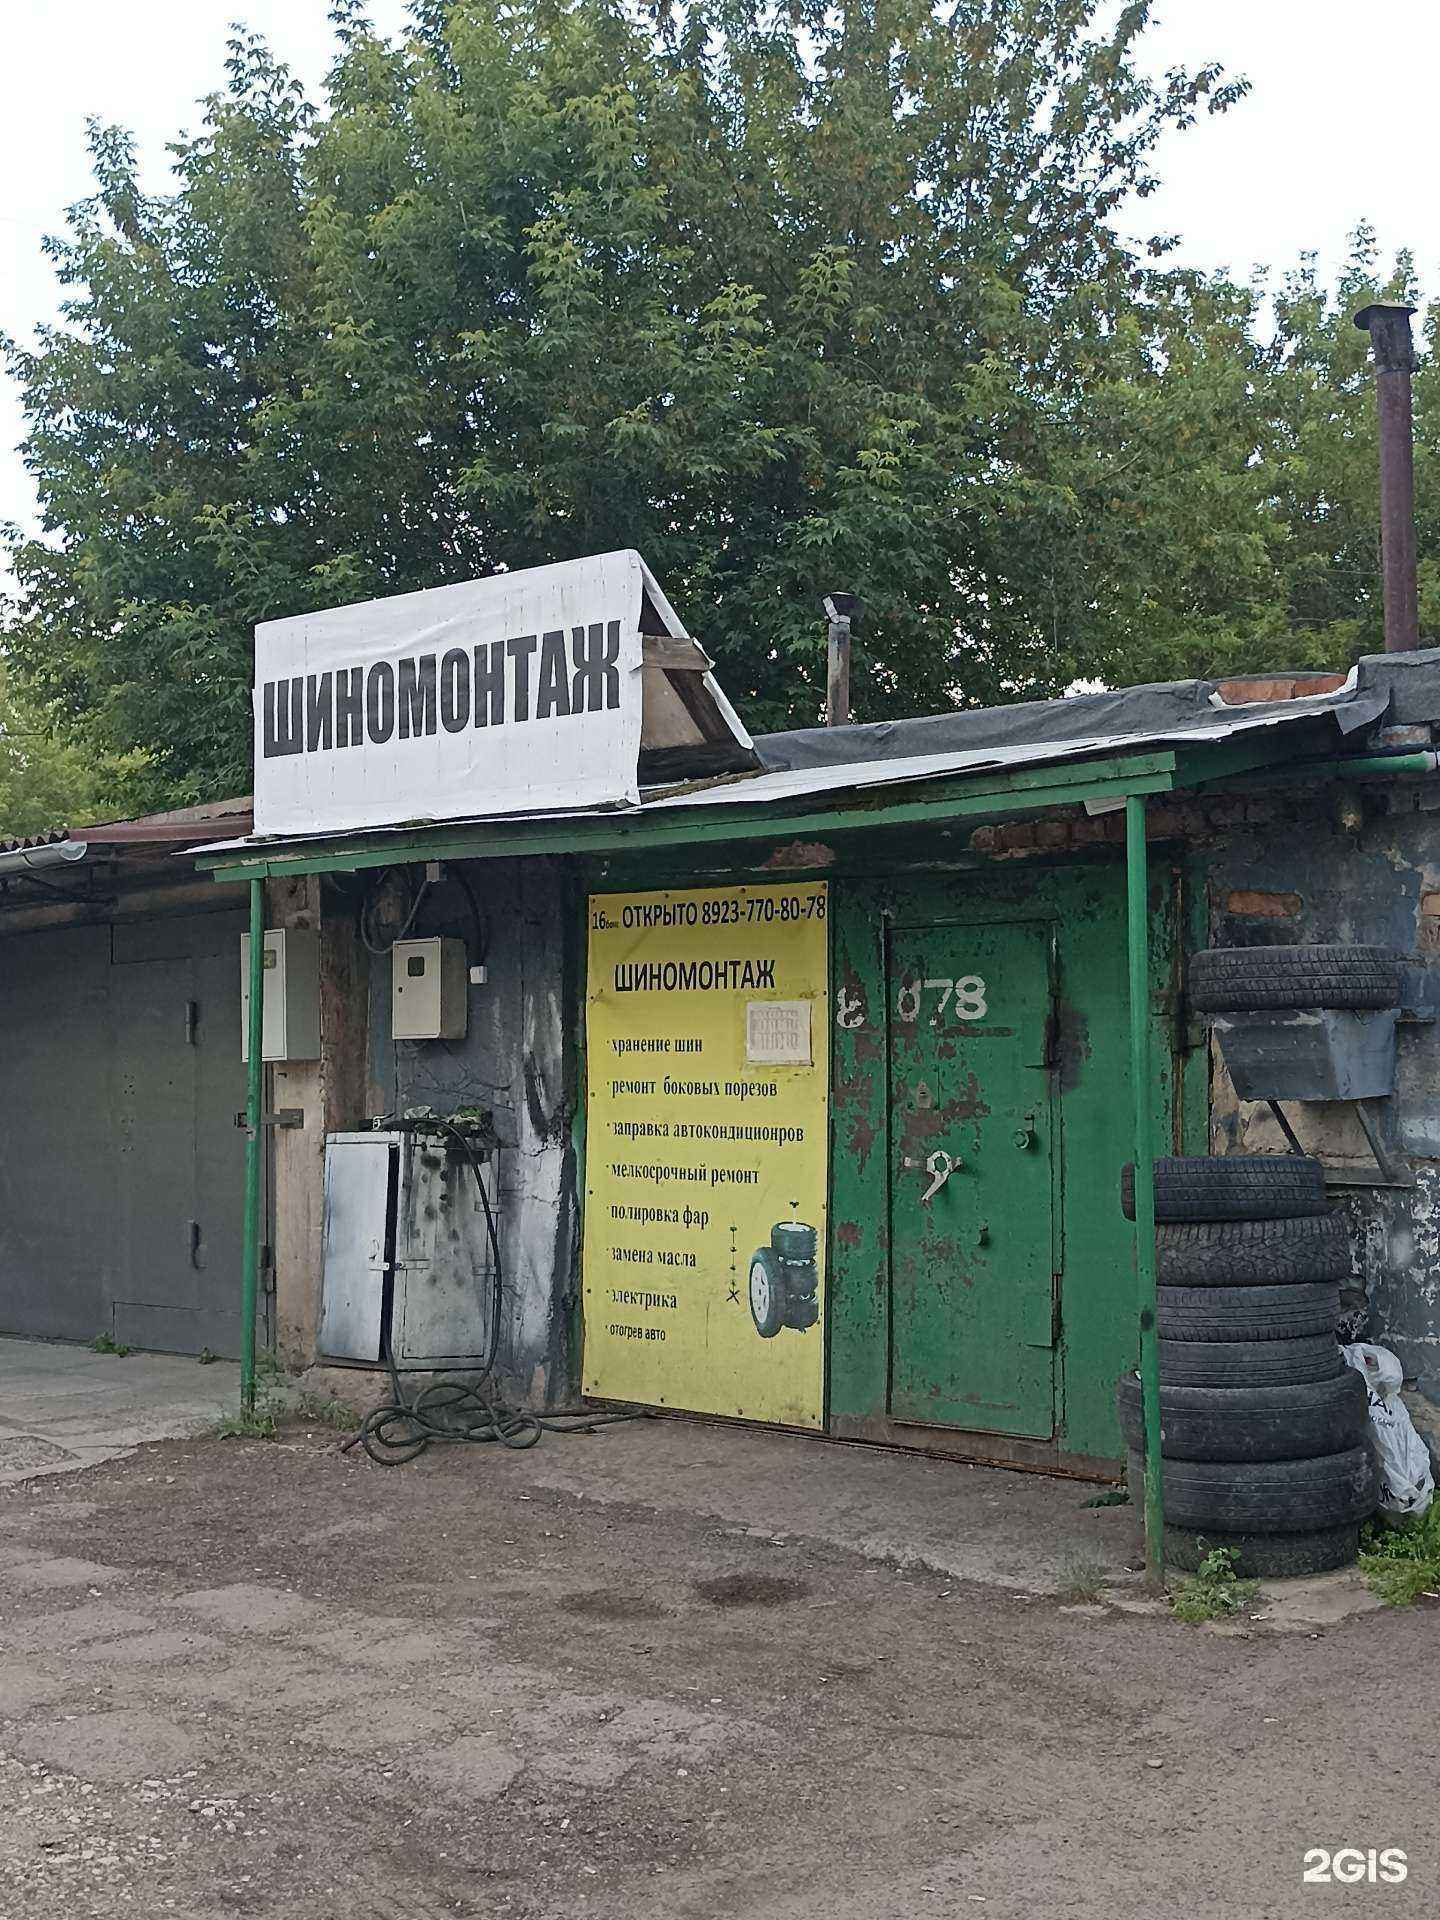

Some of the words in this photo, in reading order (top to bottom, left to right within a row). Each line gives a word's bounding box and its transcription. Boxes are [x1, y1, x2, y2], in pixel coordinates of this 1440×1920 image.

[263, 620, 621, 759] ШИНОМОНТАЖ
[622, 902, 698, 929] ОТКРЫТО
[702, 895, 826, 925] 8923-770-80-78
[614, 960, 776, 991] ШИНОМОНТАЖ
[612, 1039, 671, 1057] хранение
[674, 1039, 703, 1053] шин
[612, 1080, 656, 1099] ремонт
[663, 1075, 720, 1096] боковых
[724, 1081, 778, 1101] порезов
[612, 1121, 670, 1141] заправка
[611, 1162, 707, 1184] мелкосрочный
[711, 1167, 760, 1187] ремонт
[611, 1204, 679, 1226] полировка
[682, 1205, 709, 1230] фар
[611, 1247, 653, 1264] замена
[657, 1251, 697, 1268] масла
[611, 1288, 678, 1311] электрика
[609, 1324, 643, 1340] отогрев
[645, 1328, 666, 1341] авто
